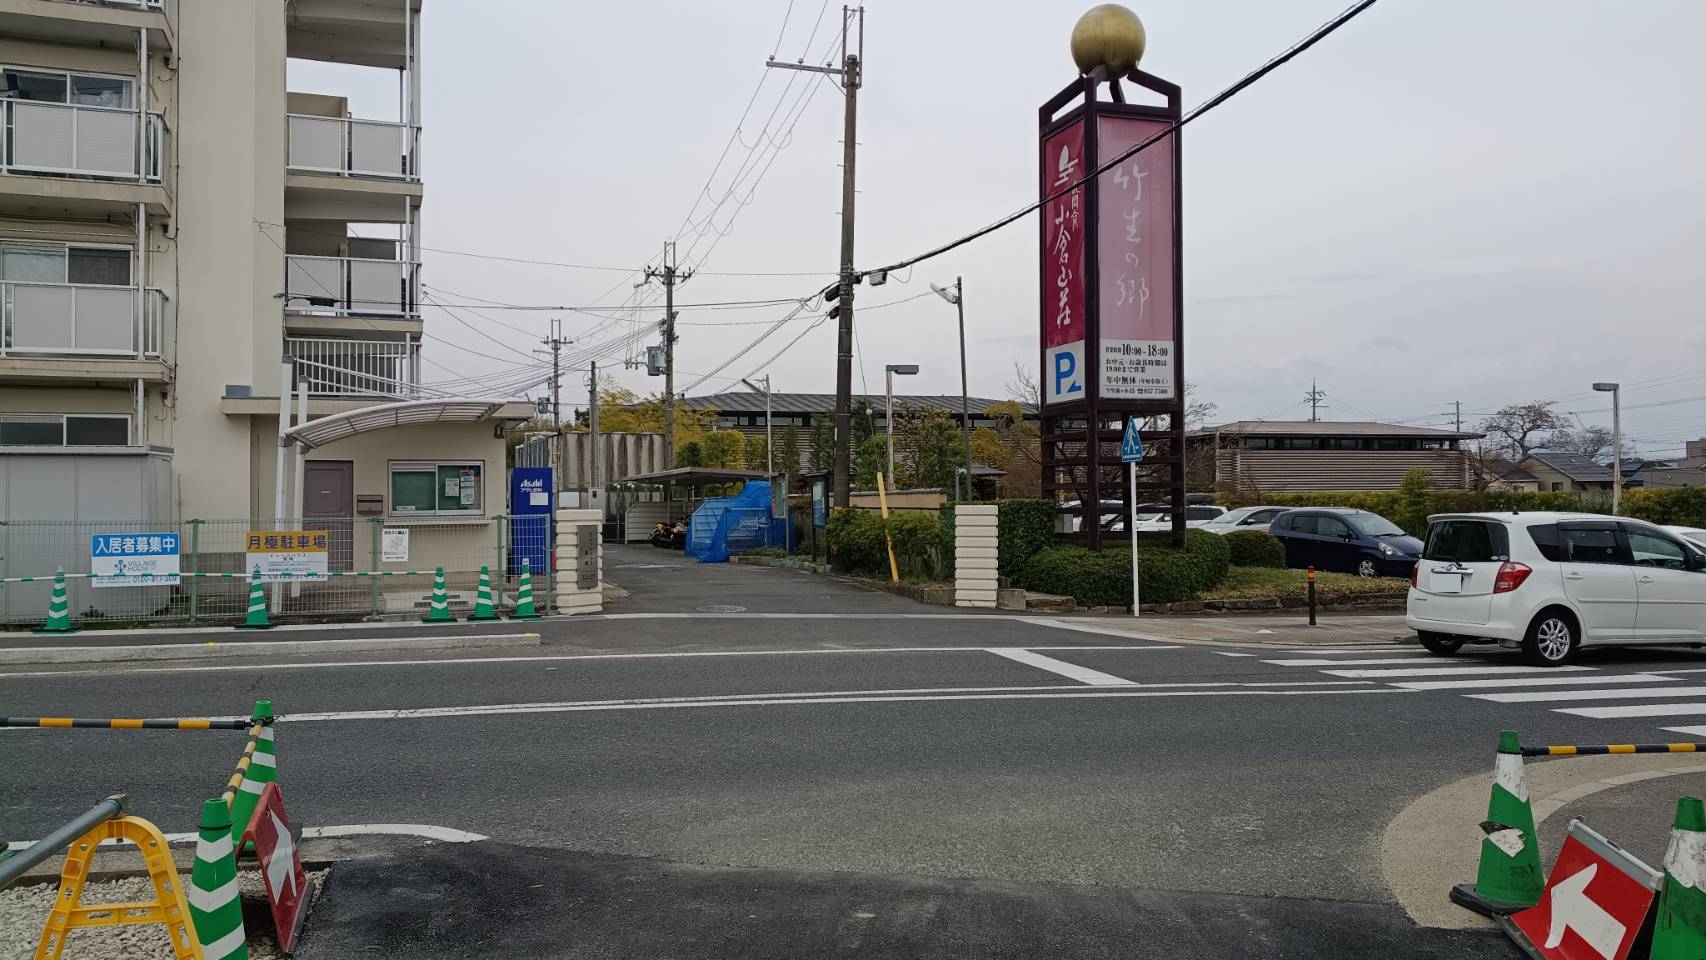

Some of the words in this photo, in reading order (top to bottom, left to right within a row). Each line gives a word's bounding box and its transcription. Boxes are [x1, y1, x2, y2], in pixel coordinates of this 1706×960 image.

[1112, 163, 1150, 321] 竹生の郷
[1053, 204, 1073, 328] 小倉山荘
[1055, 351, 1076, 396] P
[1105, 375, 1137, 385] 年中無休
[520, 478, 543, 488] Asahi
[95, 536, 176, 555] 入居者募集中
[248, 534, 327, 550] 月極駐車場
